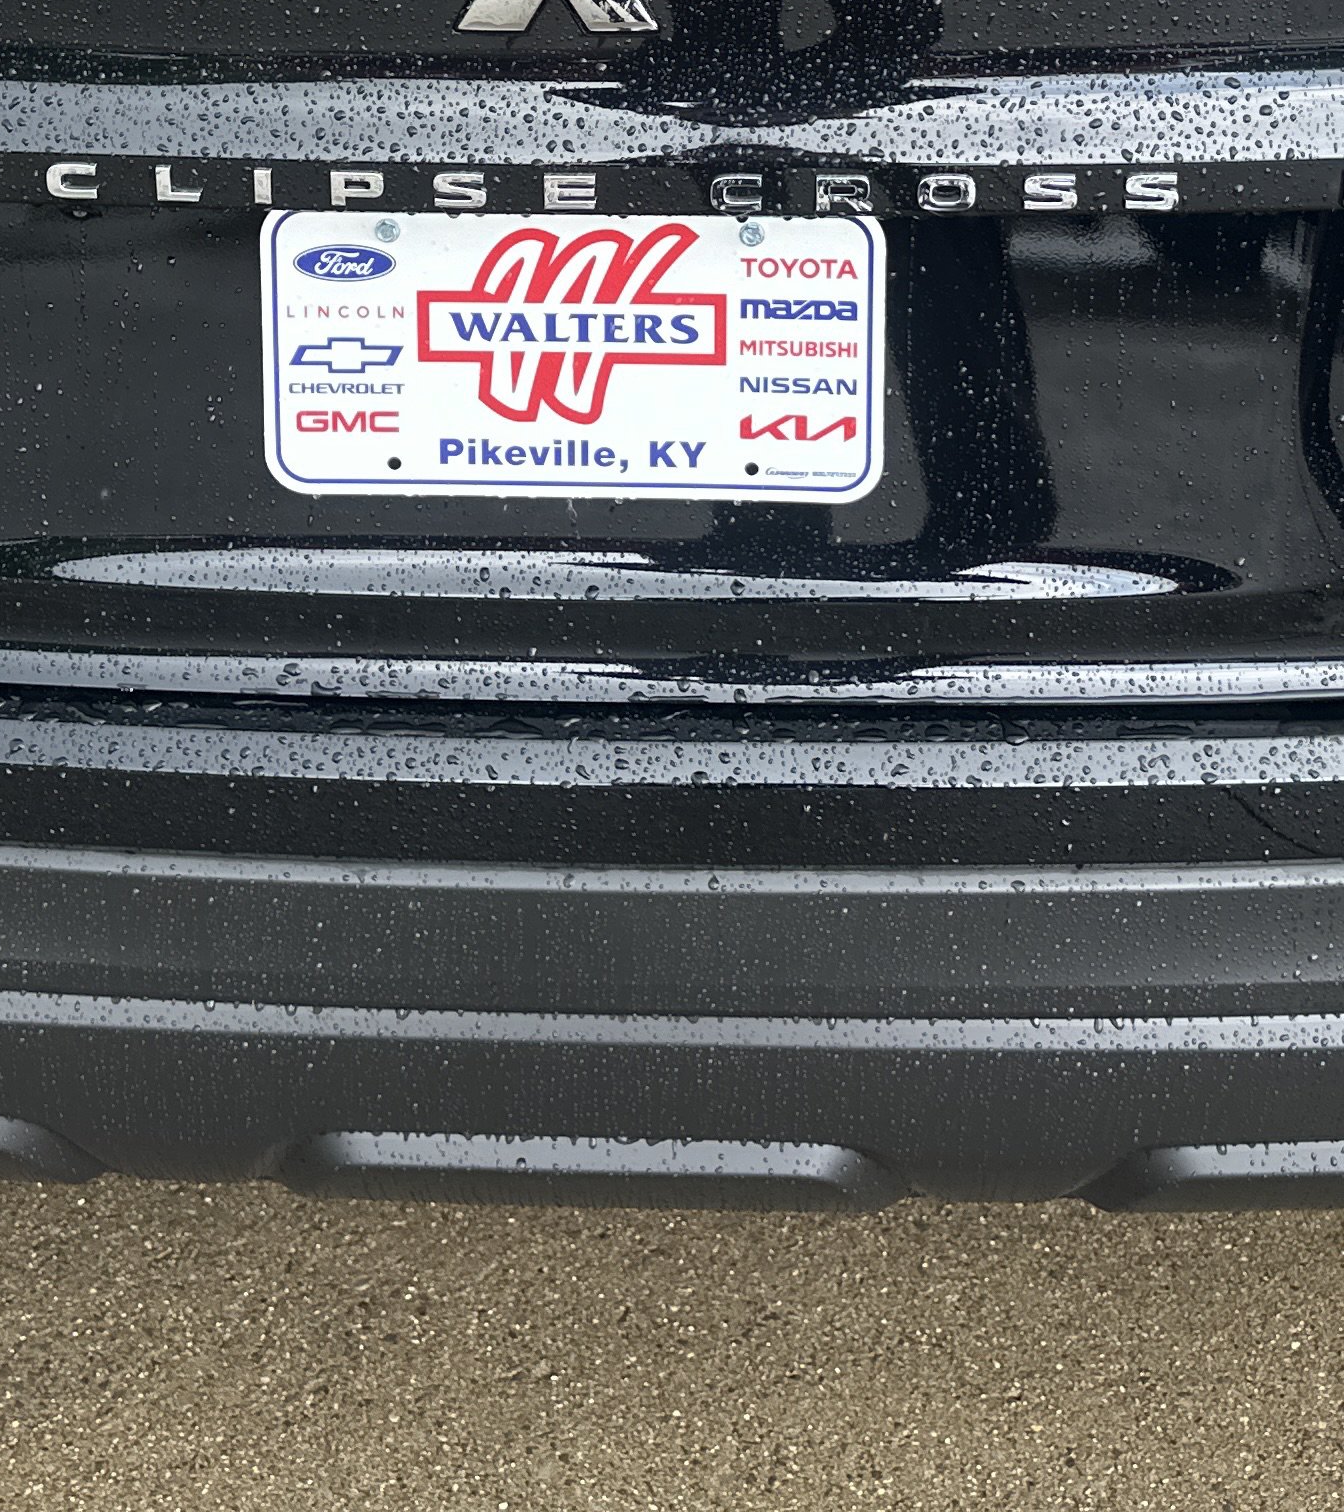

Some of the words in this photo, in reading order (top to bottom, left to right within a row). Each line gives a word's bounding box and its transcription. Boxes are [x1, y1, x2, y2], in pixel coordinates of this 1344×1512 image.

[710, 172, 1180, 211] CROSS
[314, 250, 375, 276] Ford
[739, 257, 858, 279] TOYOTA
[286, 305, 405, 319] LINCOLN
[448, 311, 700, 345] WALTERS
[739, 339, 858, 358] MITSUBISHI
[288, 382, 406, 395] CHEVROLET
[739, 376, 858, 396] NISSAN
[296, 410, 400, 433] GMC
[739, 414, 857, 443] KIA
[439, 438, 629, 474] Pikeville,
[649, 440, 708, 469] KY
